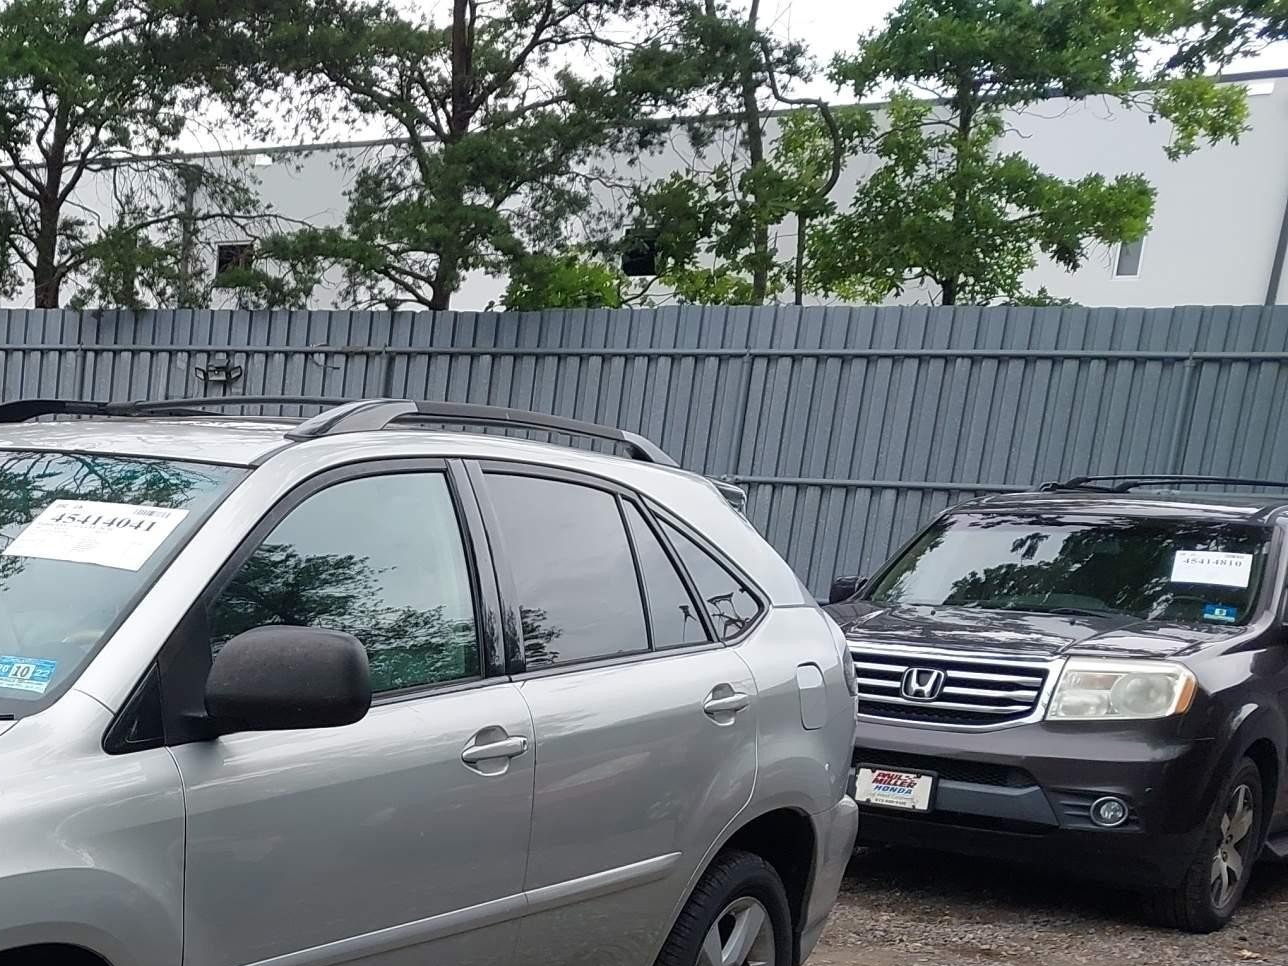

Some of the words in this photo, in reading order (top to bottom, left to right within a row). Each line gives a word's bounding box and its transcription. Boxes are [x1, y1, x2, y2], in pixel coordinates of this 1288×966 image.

[50, 513, 158, 532] 45414041
[11, 664, 31, 678] 10
[872, 778, 917, 789] MILLER
[873, 785, 913, 795] HONDA
